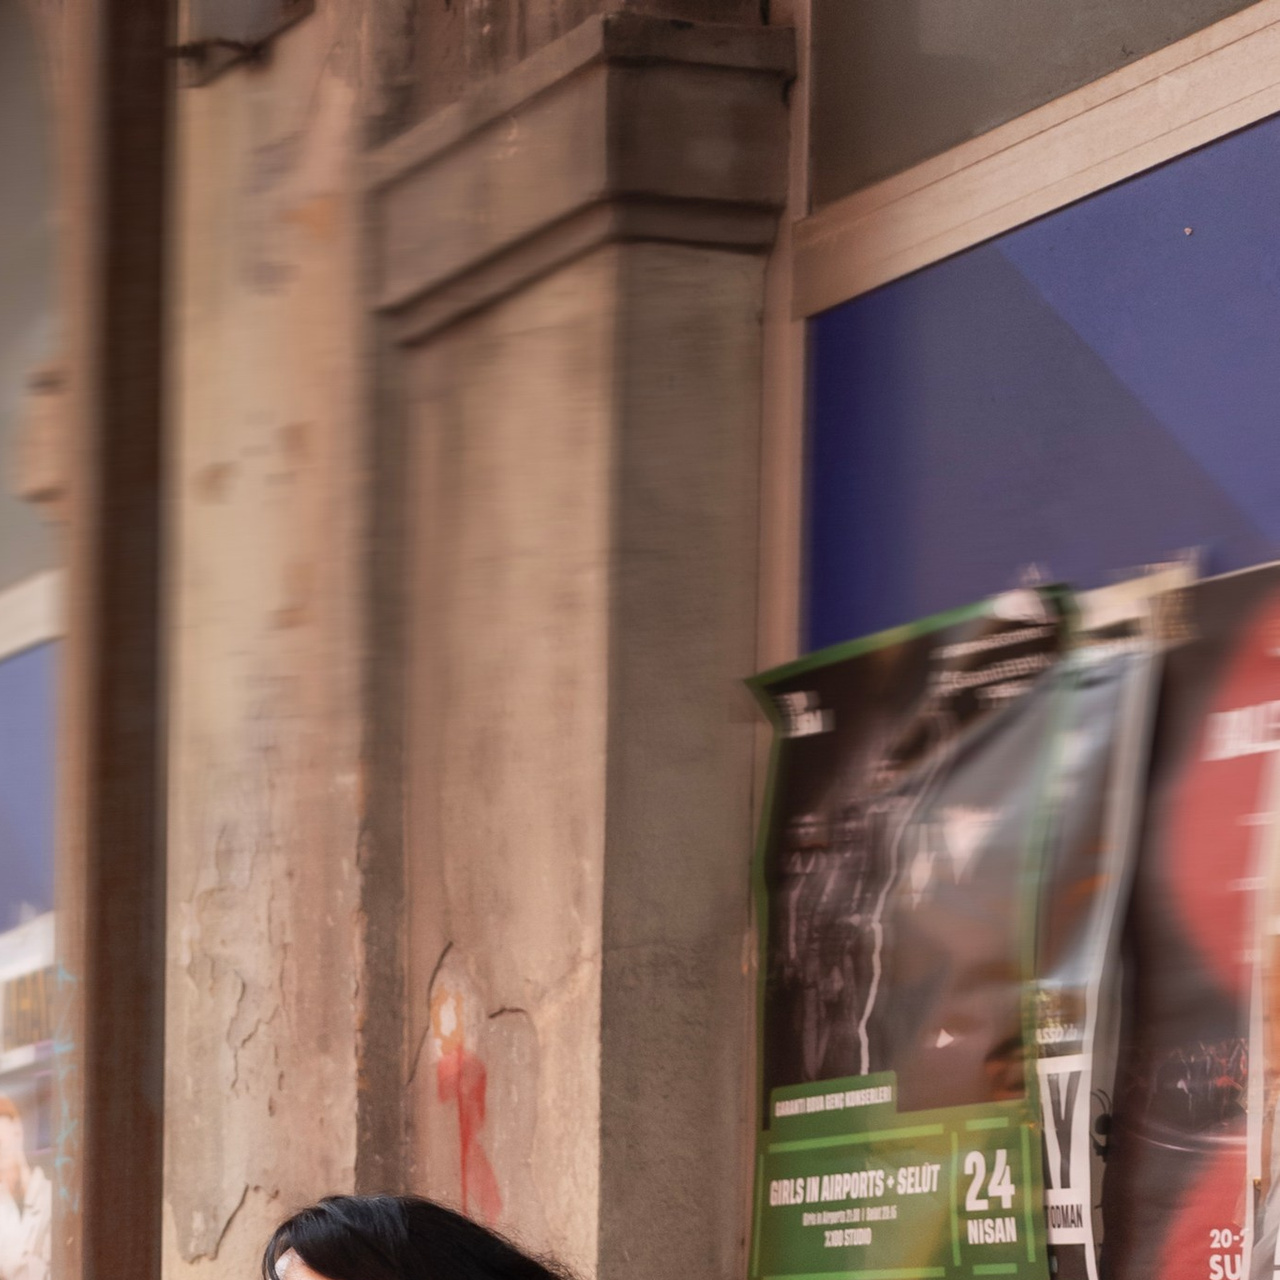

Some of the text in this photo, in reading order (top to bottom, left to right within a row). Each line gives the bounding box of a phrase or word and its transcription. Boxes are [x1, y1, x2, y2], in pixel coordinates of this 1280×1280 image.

[770, 1177, 804, 1207] GIRLS
[806, 1176, 820, 1203] IN
[820, 1169, 885, 1201] AIRPORTS
[963, 1148, 1016, 1212] 24
